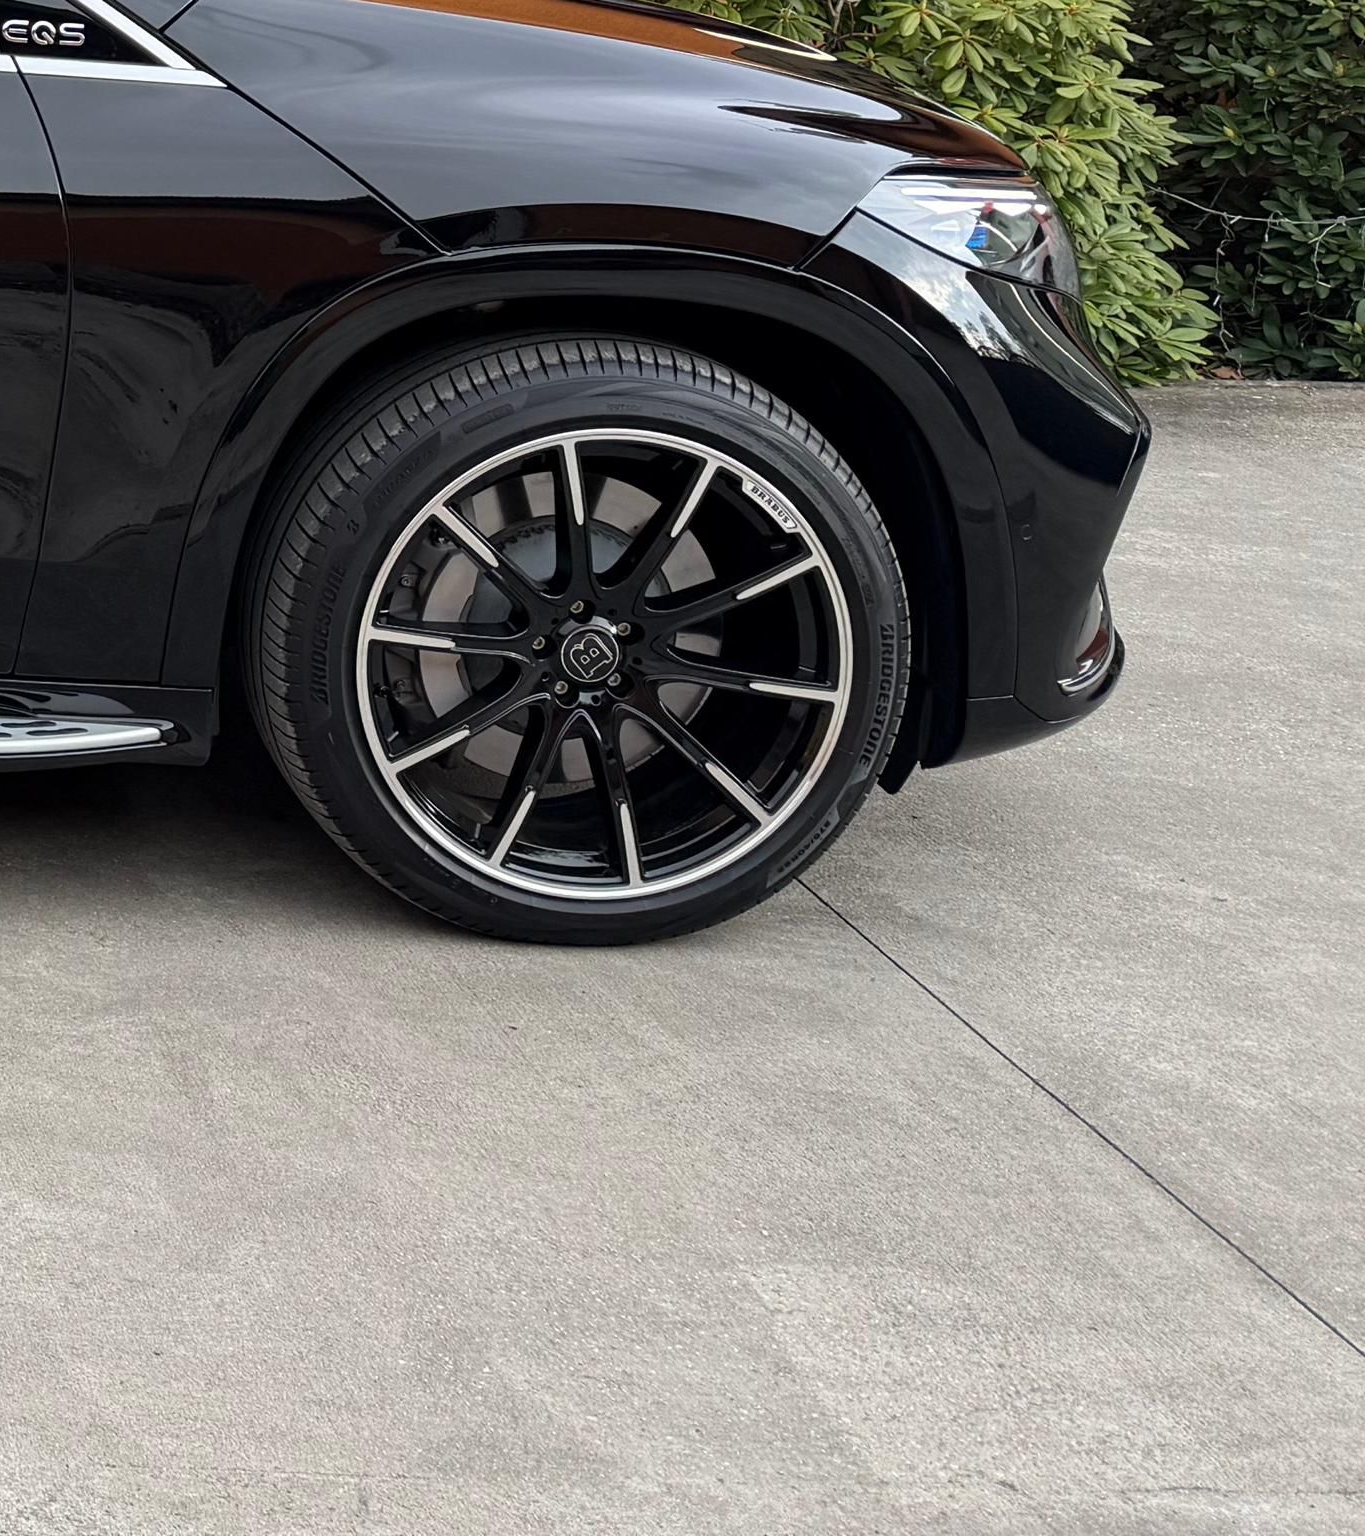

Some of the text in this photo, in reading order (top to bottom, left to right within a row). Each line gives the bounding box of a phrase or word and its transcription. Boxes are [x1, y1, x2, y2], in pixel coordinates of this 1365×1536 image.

[2, 19, 86, 47] EQS
[750, 485, 790, 524] BRABUS
[858, 623, 896, 769] BRIDGESTONE
